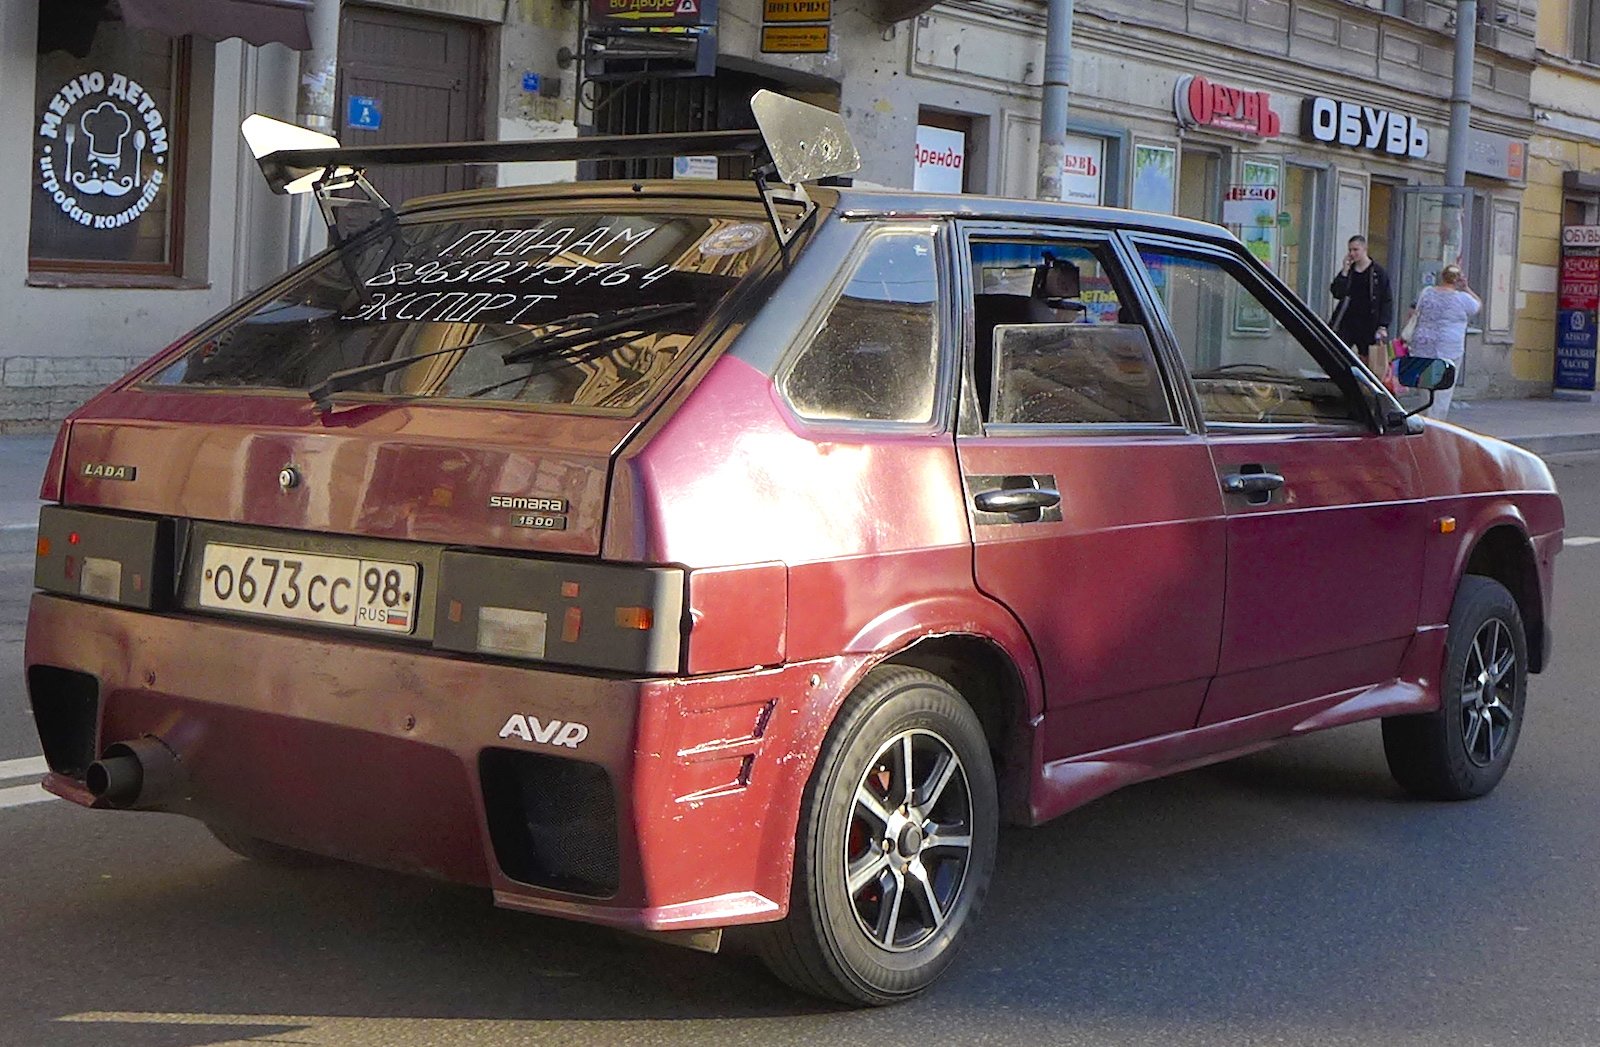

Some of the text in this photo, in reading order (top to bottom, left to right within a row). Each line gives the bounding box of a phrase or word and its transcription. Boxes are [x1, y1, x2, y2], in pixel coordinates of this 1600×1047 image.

[40, 71, 168, 154] МЕНЮ ДЕТЯМ
[1188, 74, 1280, 138] ОБУВЬ
[1312, 96, 1429, 159] ОБУВЬ
[914, 143, 963, 169] Аренда
[1064, 154, 1097, 177] БУВЬ
[39, 156, 164, 230] игровая комната
[437, 226, 655, 258] ПРОДАМ
[340, 291, 558, 325] ЭКСПОРТ
[84, 463, 125, 478] LADA
[364, 567, 402, 609] 98
[358, 607, 386, 622] RUS
